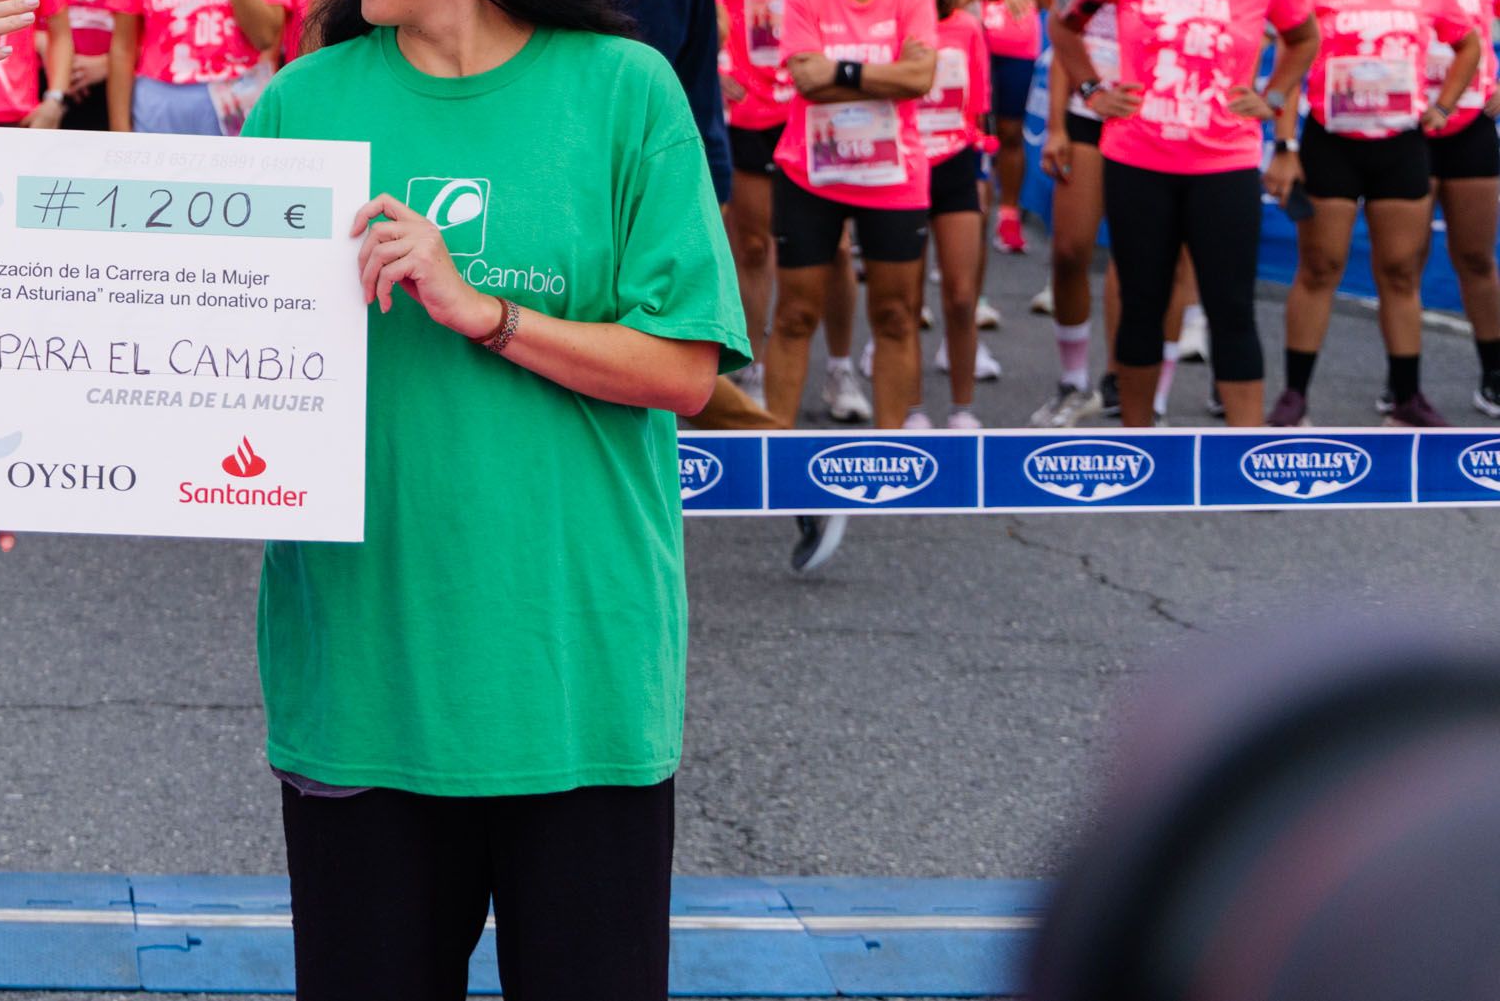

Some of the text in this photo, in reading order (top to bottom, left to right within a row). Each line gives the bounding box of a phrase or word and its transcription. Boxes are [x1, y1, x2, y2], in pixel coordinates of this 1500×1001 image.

[283, 204, 307, 229] €
[58, 263, 81, 279] de
[85, 264, 100, 280] la
[105, 265, 170, 283] Carrera
[175, 268, 197, 284] de
[202, 268, 218, 284] la
[222, 269, 270, 290] Mujer
[108, 289, 165, 306] realiza
[170, 293, 191, 307] un
[196, 291, 269, 310] donativo
[273, 297, 317, 313] para:
[109, 341, 151, 376] EL
[86, 387, 325, 413] CARRERA DE LA MUJER
[7, 461, 137, 492] OYSHO
[818, 456, 928, 481] ASTURIANA
[1032, 454, 1144, 479] ASTURIANA
[1250, 452, 1362, 477] ASTURIANA
[178, 481, 308, 507] Santander
